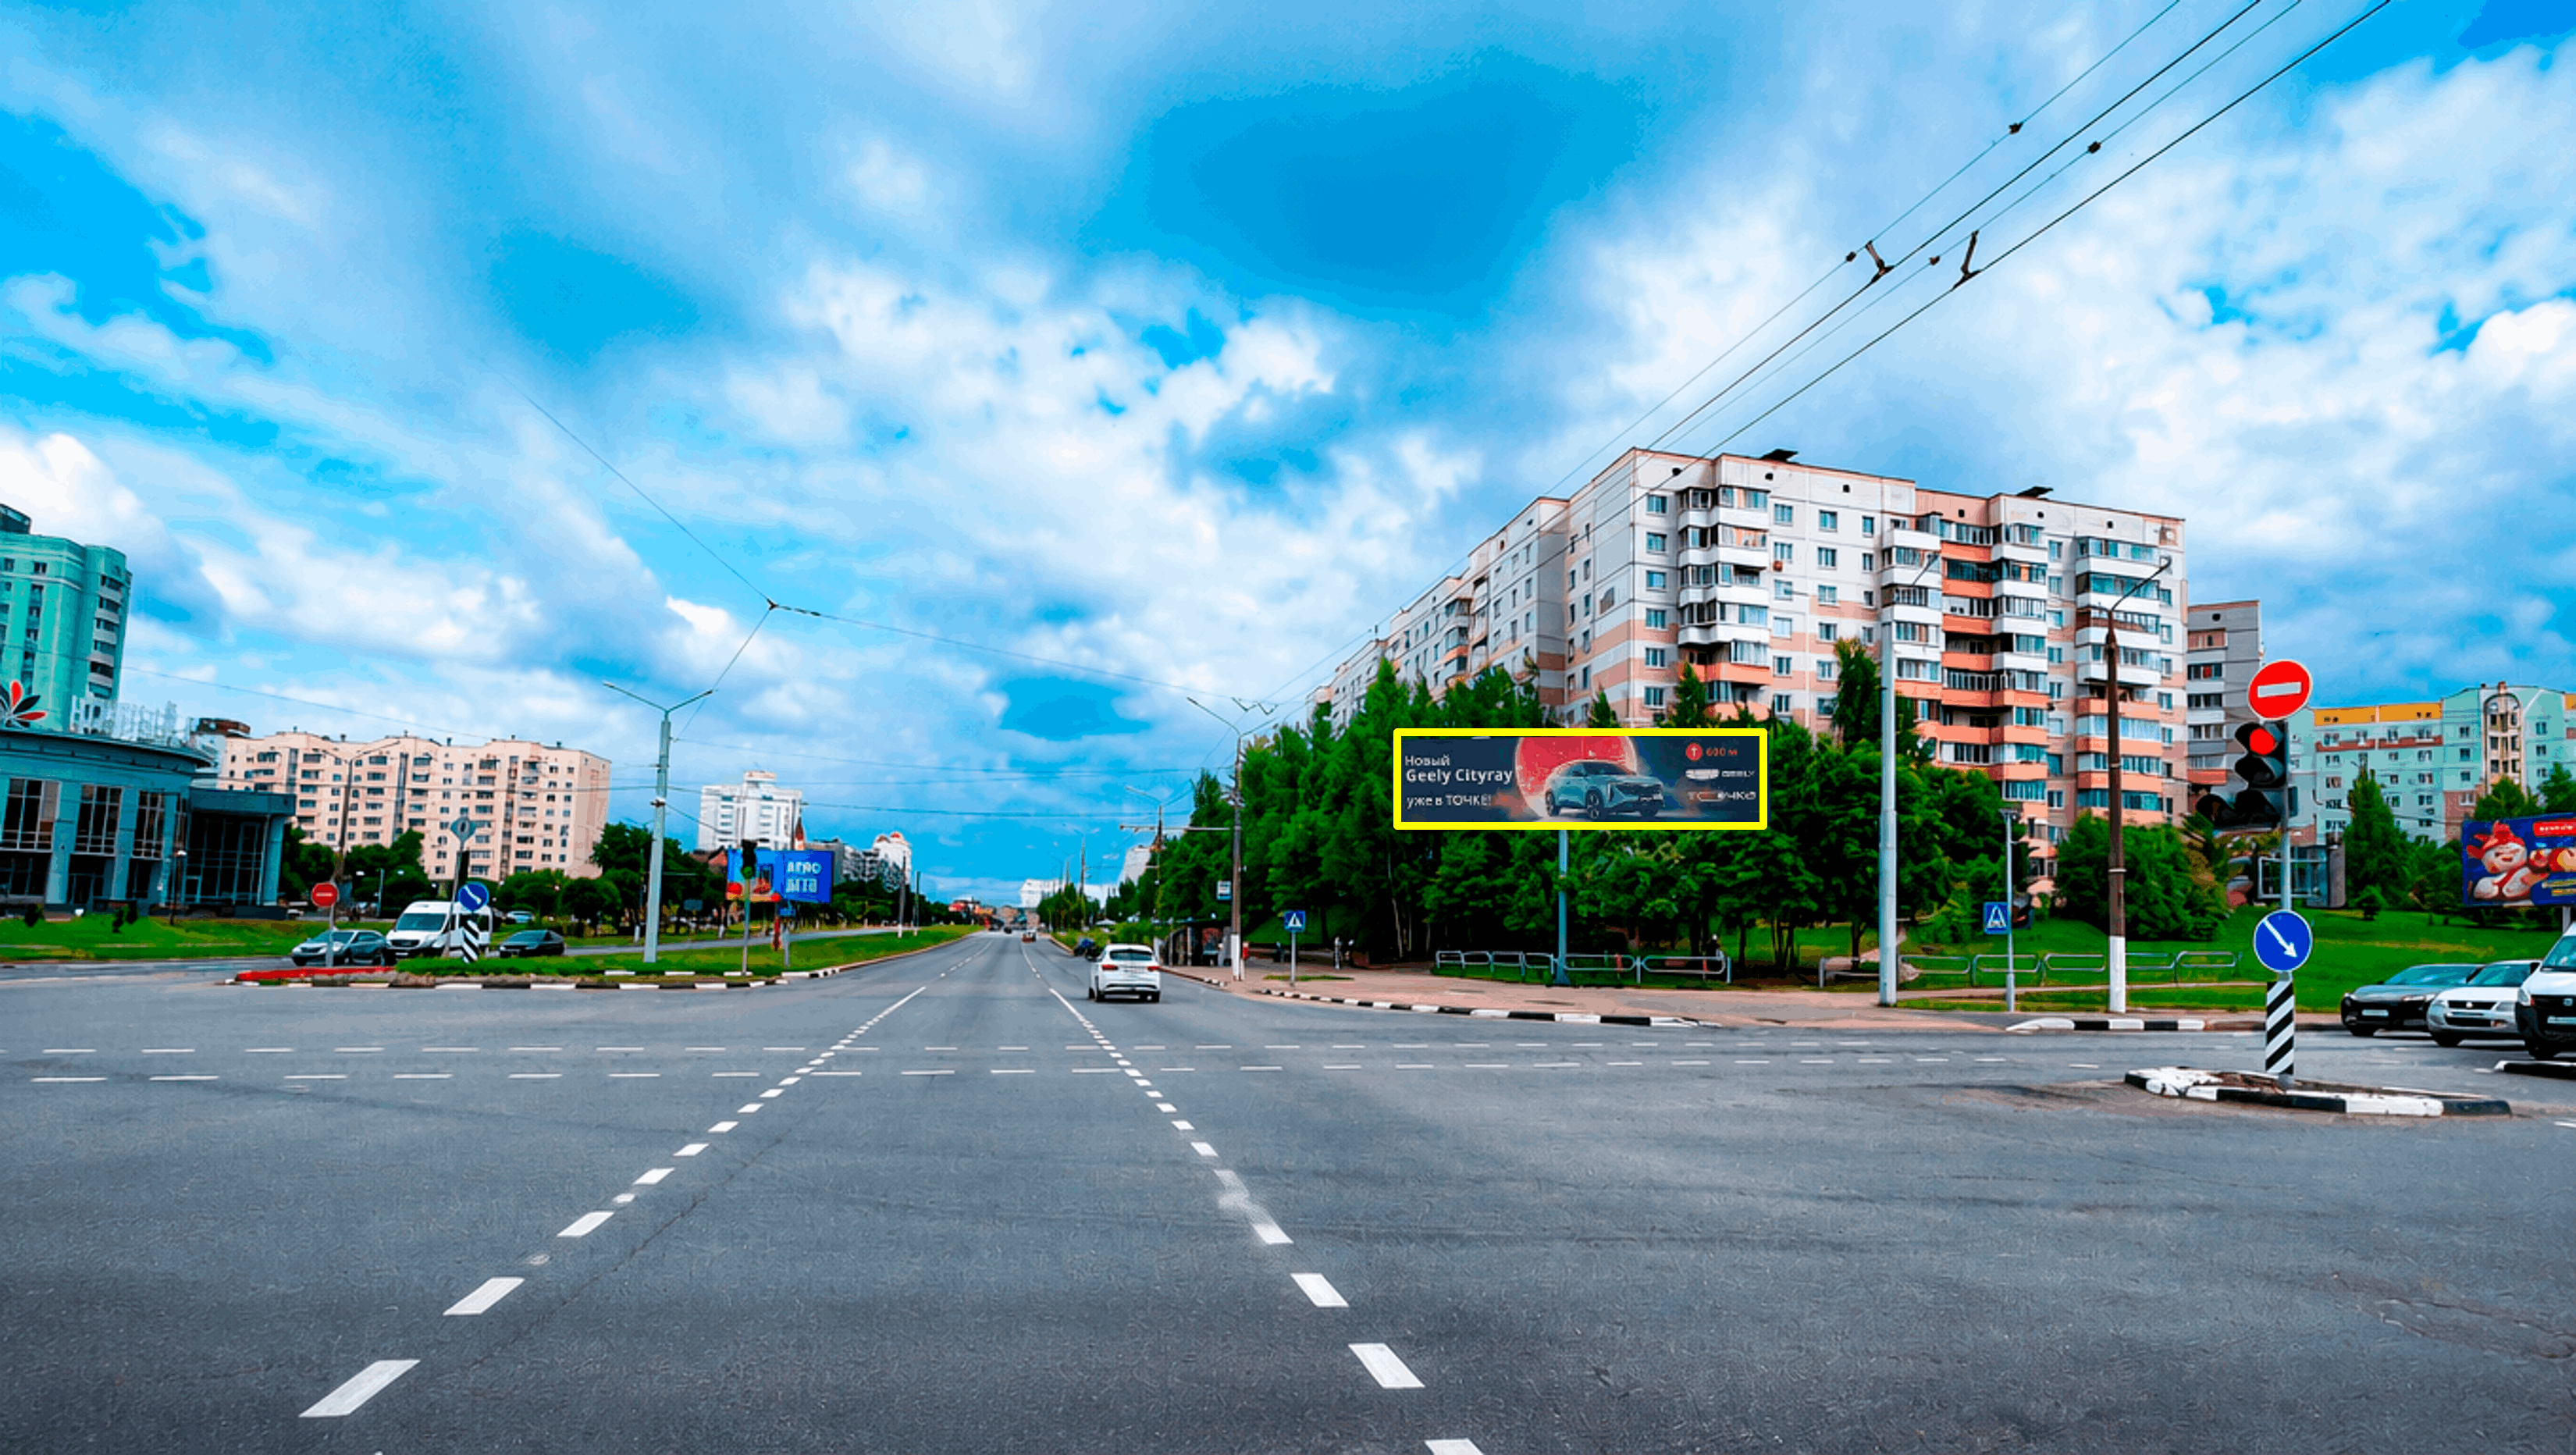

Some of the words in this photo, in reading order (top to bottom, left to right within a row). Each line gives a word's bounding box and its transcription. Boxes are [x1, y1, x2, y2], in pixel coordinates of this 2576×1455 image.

[1404, 754, 1450, 767] Новый
[1406, 768, 1451, 785] Geely
[1455, 768, 1513, 785] Cityray
[1406, 796, 1433, 809] уже
[1435, 797, 1443, 806] в
[1444, 793, 1492, 806] ТОЧКЕ!
